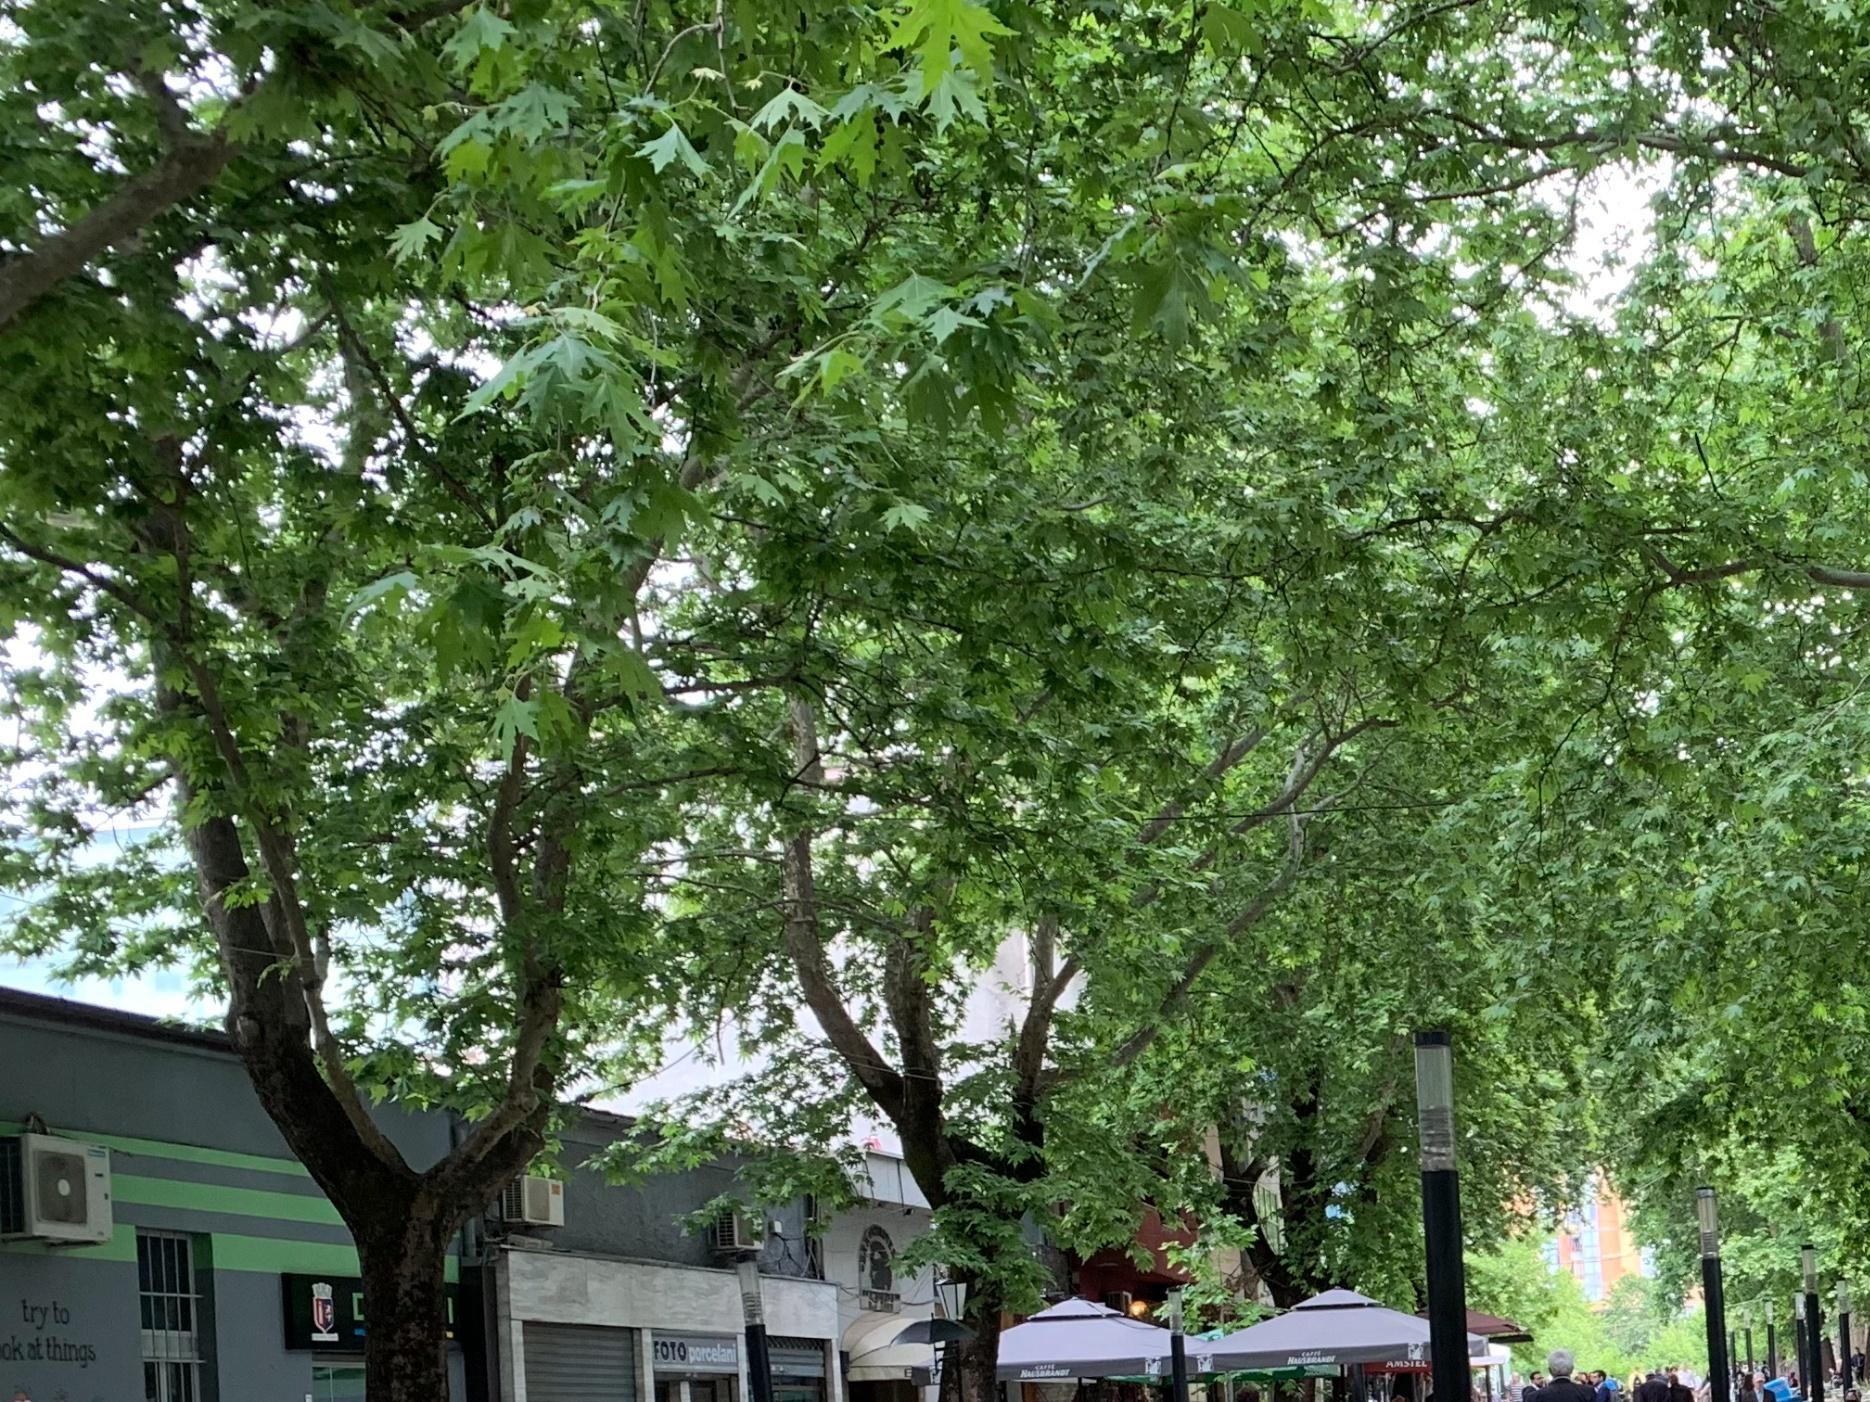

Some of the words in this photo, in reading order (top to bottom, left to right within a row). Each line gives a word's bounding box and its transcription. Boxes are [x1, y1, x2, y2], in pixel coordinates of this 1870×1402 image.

[22, 1299, 48, 1331] try
[52, 1300, 70, 1325] to
[0, 1335, 25, 1361] ok
[27, 1338, 44, 1361] at
[45, 1336, 97, 1368] things
[654, 1341, 687, 1361] FOTO
[688, 1344, 737, 1364] porcelani
[1385, 1360, 1428, 1368] AMSTEL
